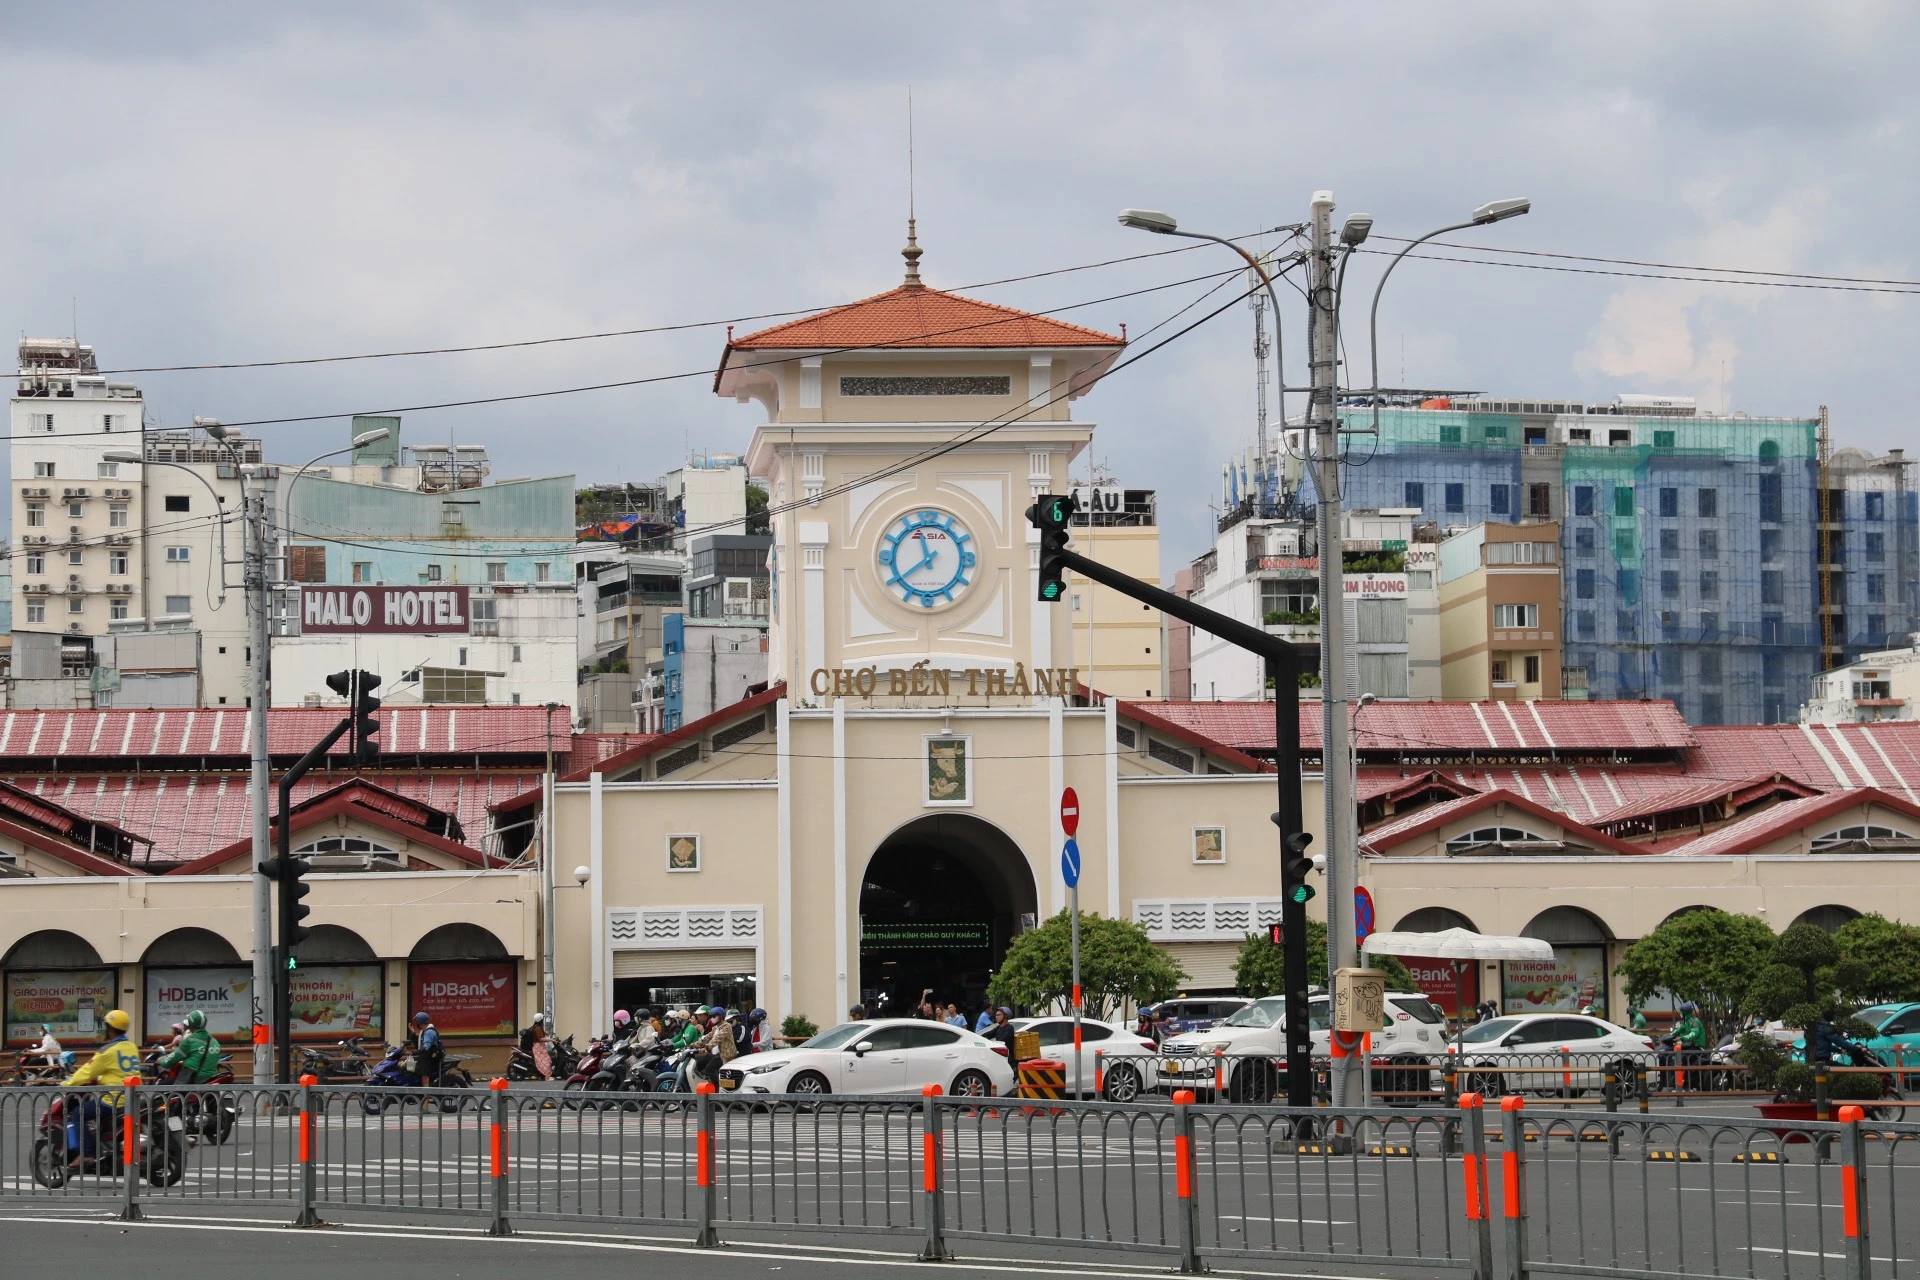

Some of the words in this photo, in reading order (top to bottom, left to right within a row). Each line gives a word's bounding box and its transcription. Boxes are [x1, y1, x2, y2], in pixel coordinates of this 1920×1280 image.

[918, 511, 938, 526] 12
[1053, 501, 1063, 521] 6
[911, 530, 946, 540] ASIA
[879, 550, 892, 565] 9
[963, 552, 976, 567] 3
[1362, 581, 1405, 593] HUONG
[921, 592, 935, 608] 6
[305, 591, 372, 626] HALO
[384, 591, 465, 626] HOTEL
[811, 665, 877, 699] CHỢ
[889, 659, 951, 696] BẾN
[963, 662, 1080, 696] THÀNH
[1409, 967, 1451, 981] Bank
[14, 988, 38, 997] GIAO
[39, 988, 60, 998] DỊCH
[76, 987, 108, 996] TRONG
[158, 987, 229, 1002] HDBank
[289, 993, 309, 1003] RỌN
[339, 991, 354, 1001] PHÍ
[422, 982, 489, 997] HDBank
[198, 1045, 220, 1054] Gab
[117, 1050, 140, 1072] be
